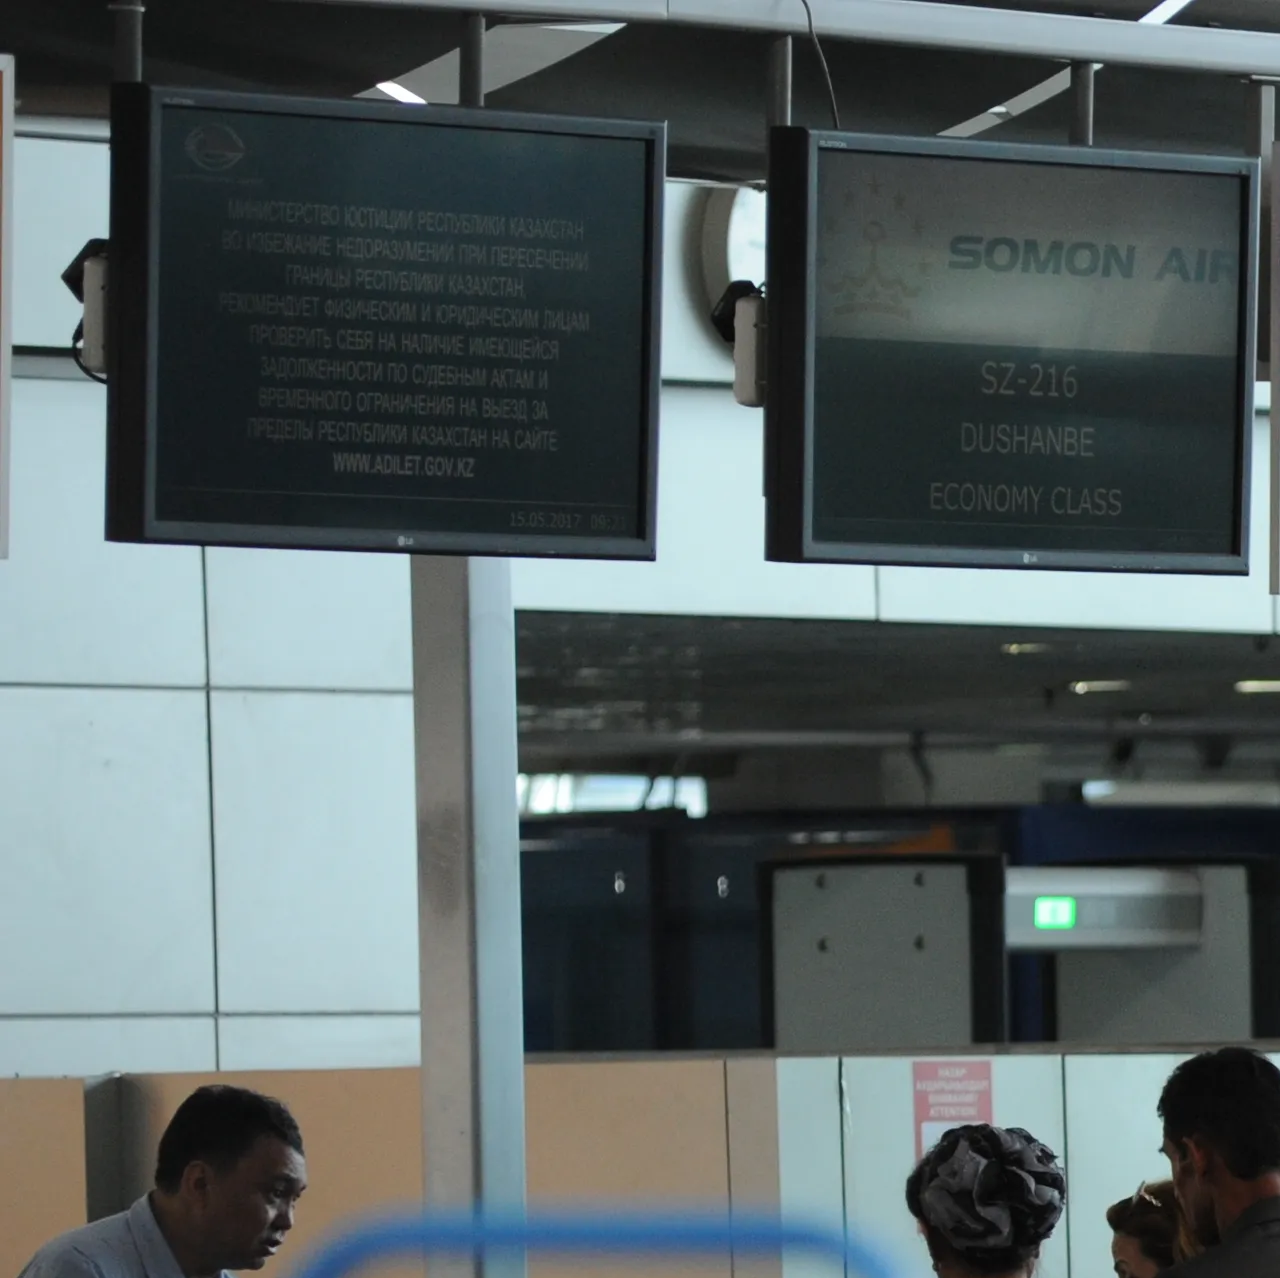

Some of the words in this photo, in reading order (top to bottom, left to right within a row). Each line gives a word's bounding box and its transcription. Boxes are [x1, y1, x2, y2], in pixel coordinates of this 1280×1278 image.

[228, 199, 340, 226] МИНИСТЕРСТВО
[344, 206, 413, 233] ЮСТИЦИИ
[417, 211, 505, 237] РЕСПУБЛИКИ
[509, 217, 584, 240] КАЗАХСТАН
[222, 230, 242, 251] ВО
[246, 232, 332, 257] ИЗБЕЖАНИЕ
[459, 244, 486, 265] ПРИ
[491, 246, 589, 271] ПЕРЕСЕЧЕНИИ
[948, 235, 1135, 279] SOMON
[286, 263, 351, 290] ГРАНИЦЫ
[356, 268, 444, 292] РЕСПУБЛИКИ
[218, 292, 319, 318] РЕКОМЕНДУЕТ
[324, 297, 416, 323] ФИЗИЧЕСКИМ
[421, 304, 431, 322] И
[436, 304, 538, 329] ЮРИДИЧЕСКИМ
[543, 310, 590, 336] ЛИЦАМ
[249, 325, 332, 350] ПРОВЕРИТЬ
[336, 329, 373, 350] СЕБЯ
[378, 332, 396, 351] НА
[401, 332, 464, 356] НАЛИЧИЕ
[469, 336, 559, 361] ИМЕЮЩЕЙСЯ
[260, 356, 383, 381] ЗАДОЛЖЕННОСТИ
[387, 362, 407, 383] ПО
[412, 364, 487, 388] СУДЕБНЫМ
[490, 368, 535, 390] АКТАМ
[538, 370, 548, 390] И
[980, 361, 1078, 398] SZ-216
[258, 387, 351, 411] ВРЕМЕННОГО
[356, 391, 455, 416] ОГРАНИЧЕНИЯ
[459, 398, 478, 417] НА
[482, 398, 528, 423] ВЫЕЗД
[532, 401, 549, 420] ЗА
[247, 417, 313, 442] ПРЕДЕЛЫ
[317, 420, 407, 444] РЕСПУБЛИКИ
[412, 425, 487, 448] КАЗАХСТАН
[492, 428, 510, 449] НА
[514, 427, 559, 452] САЙТЕ
[960, 422, 1096, 458] DUSHANBE
[333, 452, 476, 477] WWW.ADILET.GOV.KZ
[929, 482, 1042, 514] ECONOMY
[1050, 486, 1122, 516] CLASS
[510, 511, 582, 529] 15.05.2017
